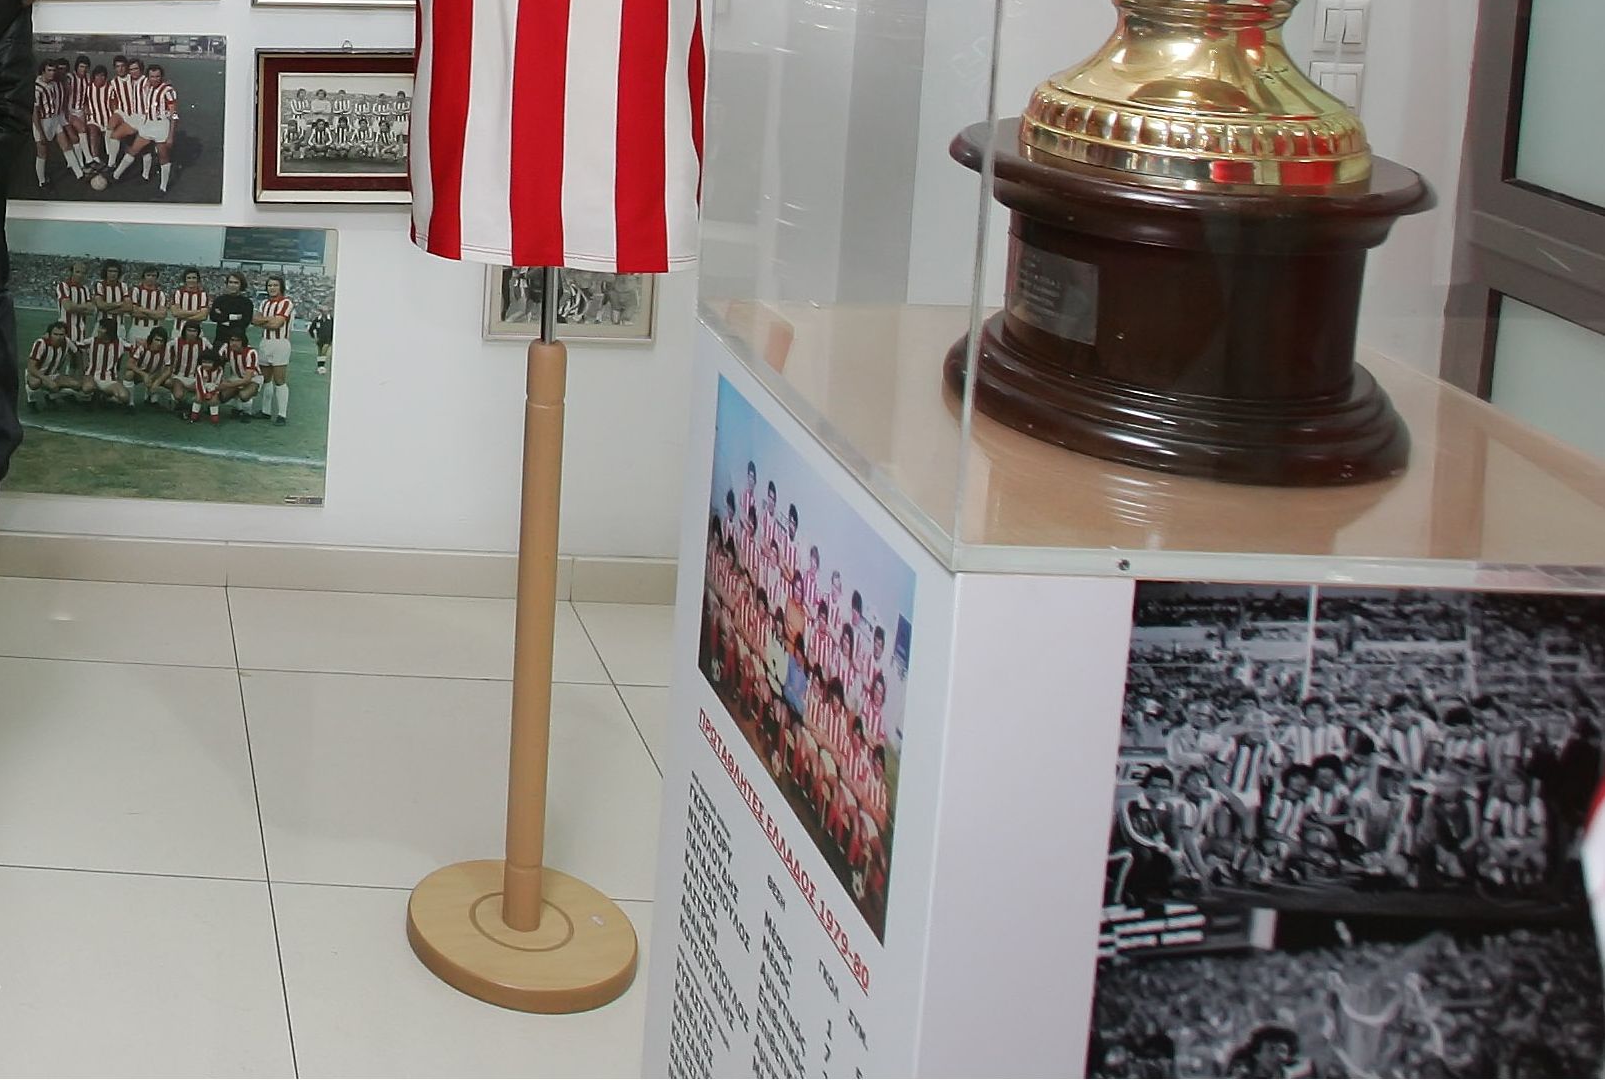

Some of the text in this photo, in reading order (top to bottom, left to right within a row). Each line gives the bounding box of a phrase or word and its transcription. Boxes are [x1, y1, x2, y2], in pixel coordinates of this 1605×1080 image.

[699, 708, 765, 823] ΠΡΩΤΑΘΛΗΤΕΣ
[766, 814, 817, 904] ΕΛΛΑΔΟΣ
[819, 899, 869, 989] 1979-80
